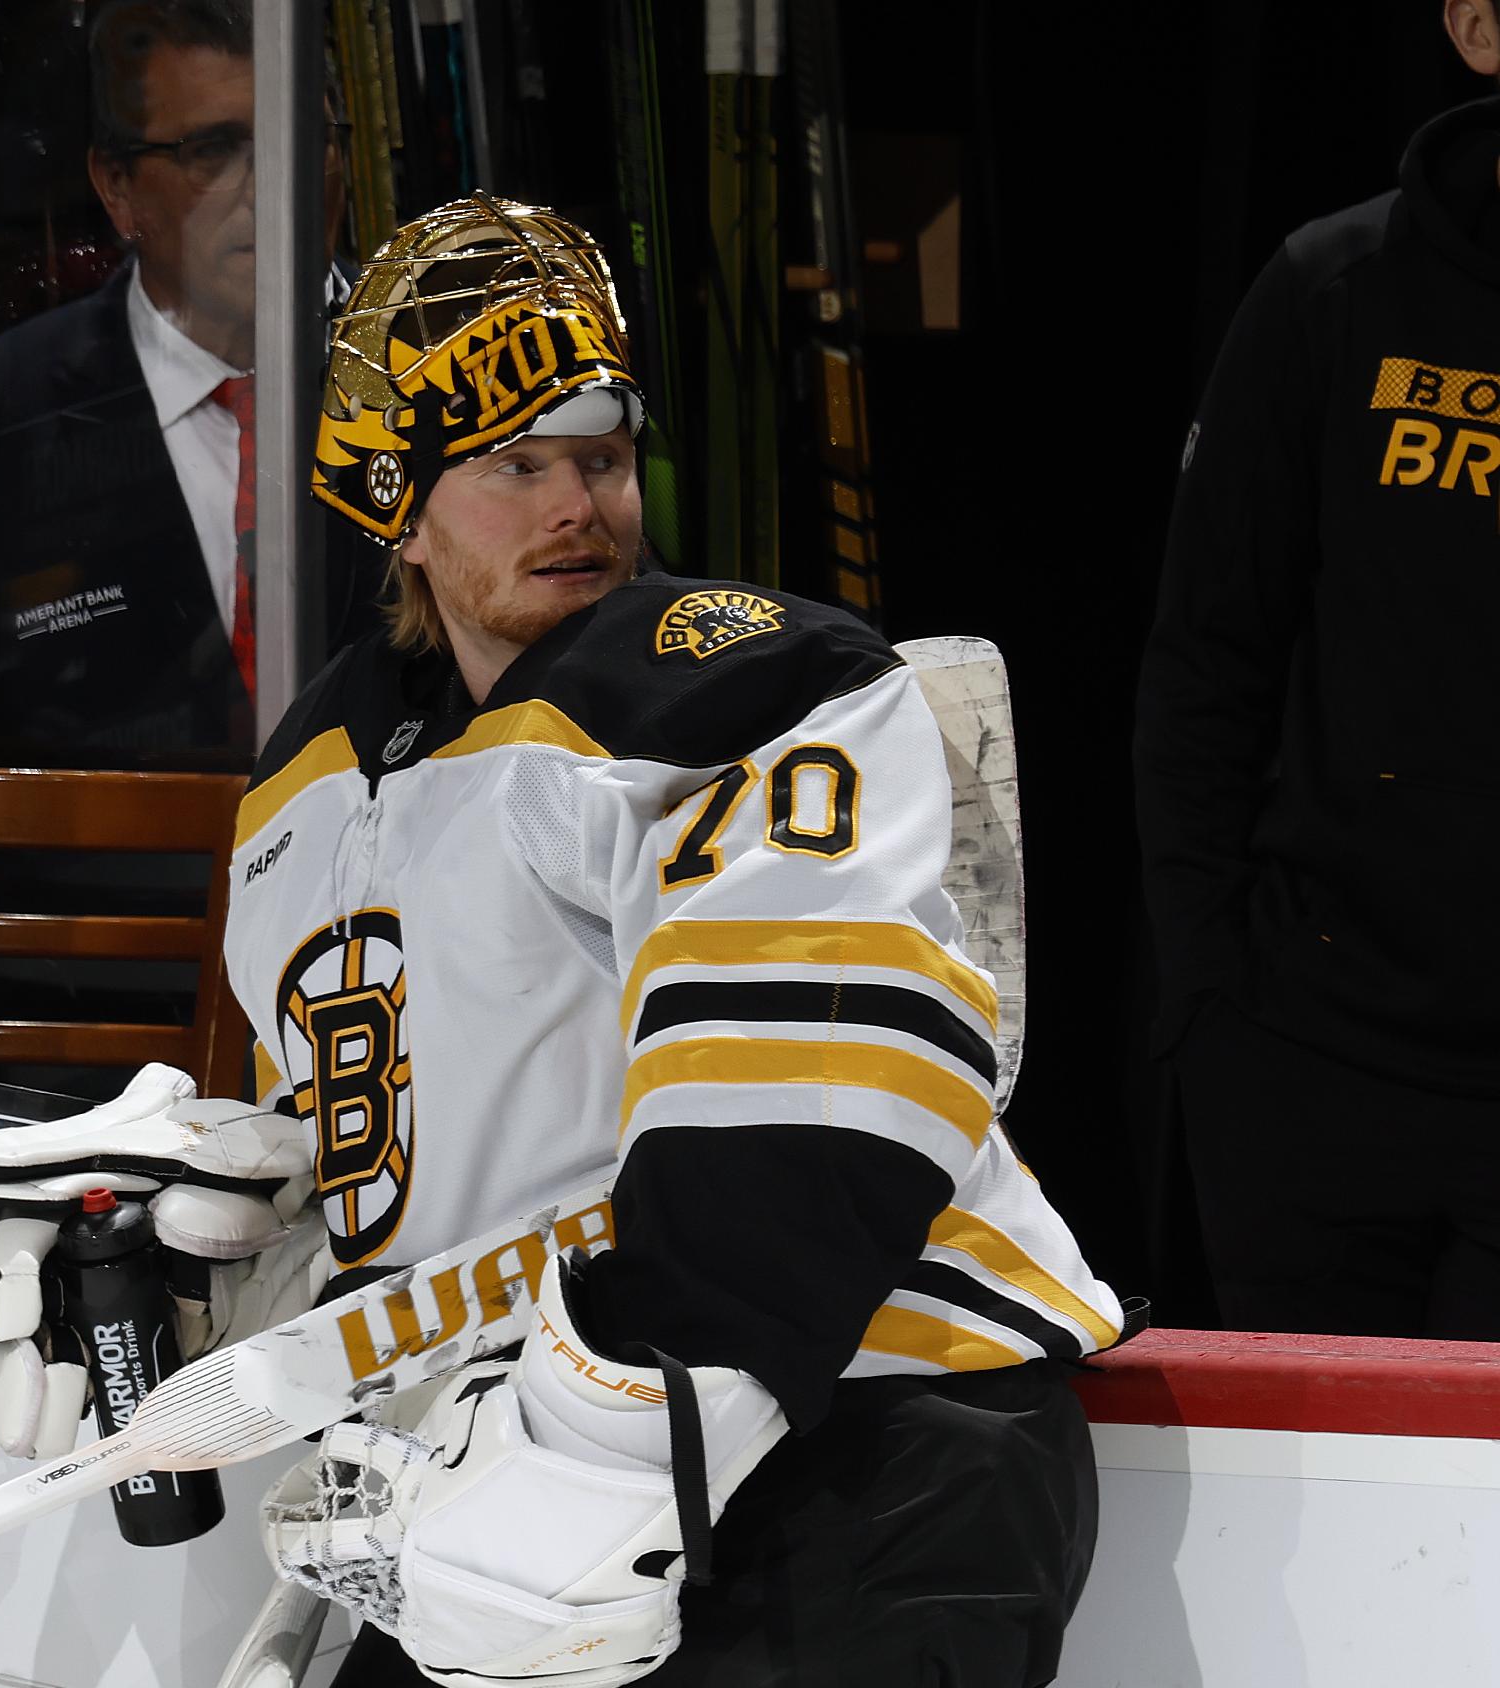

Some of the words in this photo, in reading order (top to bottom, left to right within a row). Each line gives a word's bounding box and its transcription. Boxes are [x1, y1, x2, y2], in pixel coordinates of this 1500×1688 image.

[14, 594, 85, 629] AMERANT
[86, 583, 125, 607] BANK
[48, 608, 93, 634] ARENA
[660, 592, 779, 650] BOSTON
[657, 741, 863, 897] 70
[301, 983, 403, 1195] B
[121, 1319, 140, 1359] Drink
[538, 1311, 669, 1405] TRUE
[133, 1360, 149, 1404] ports
